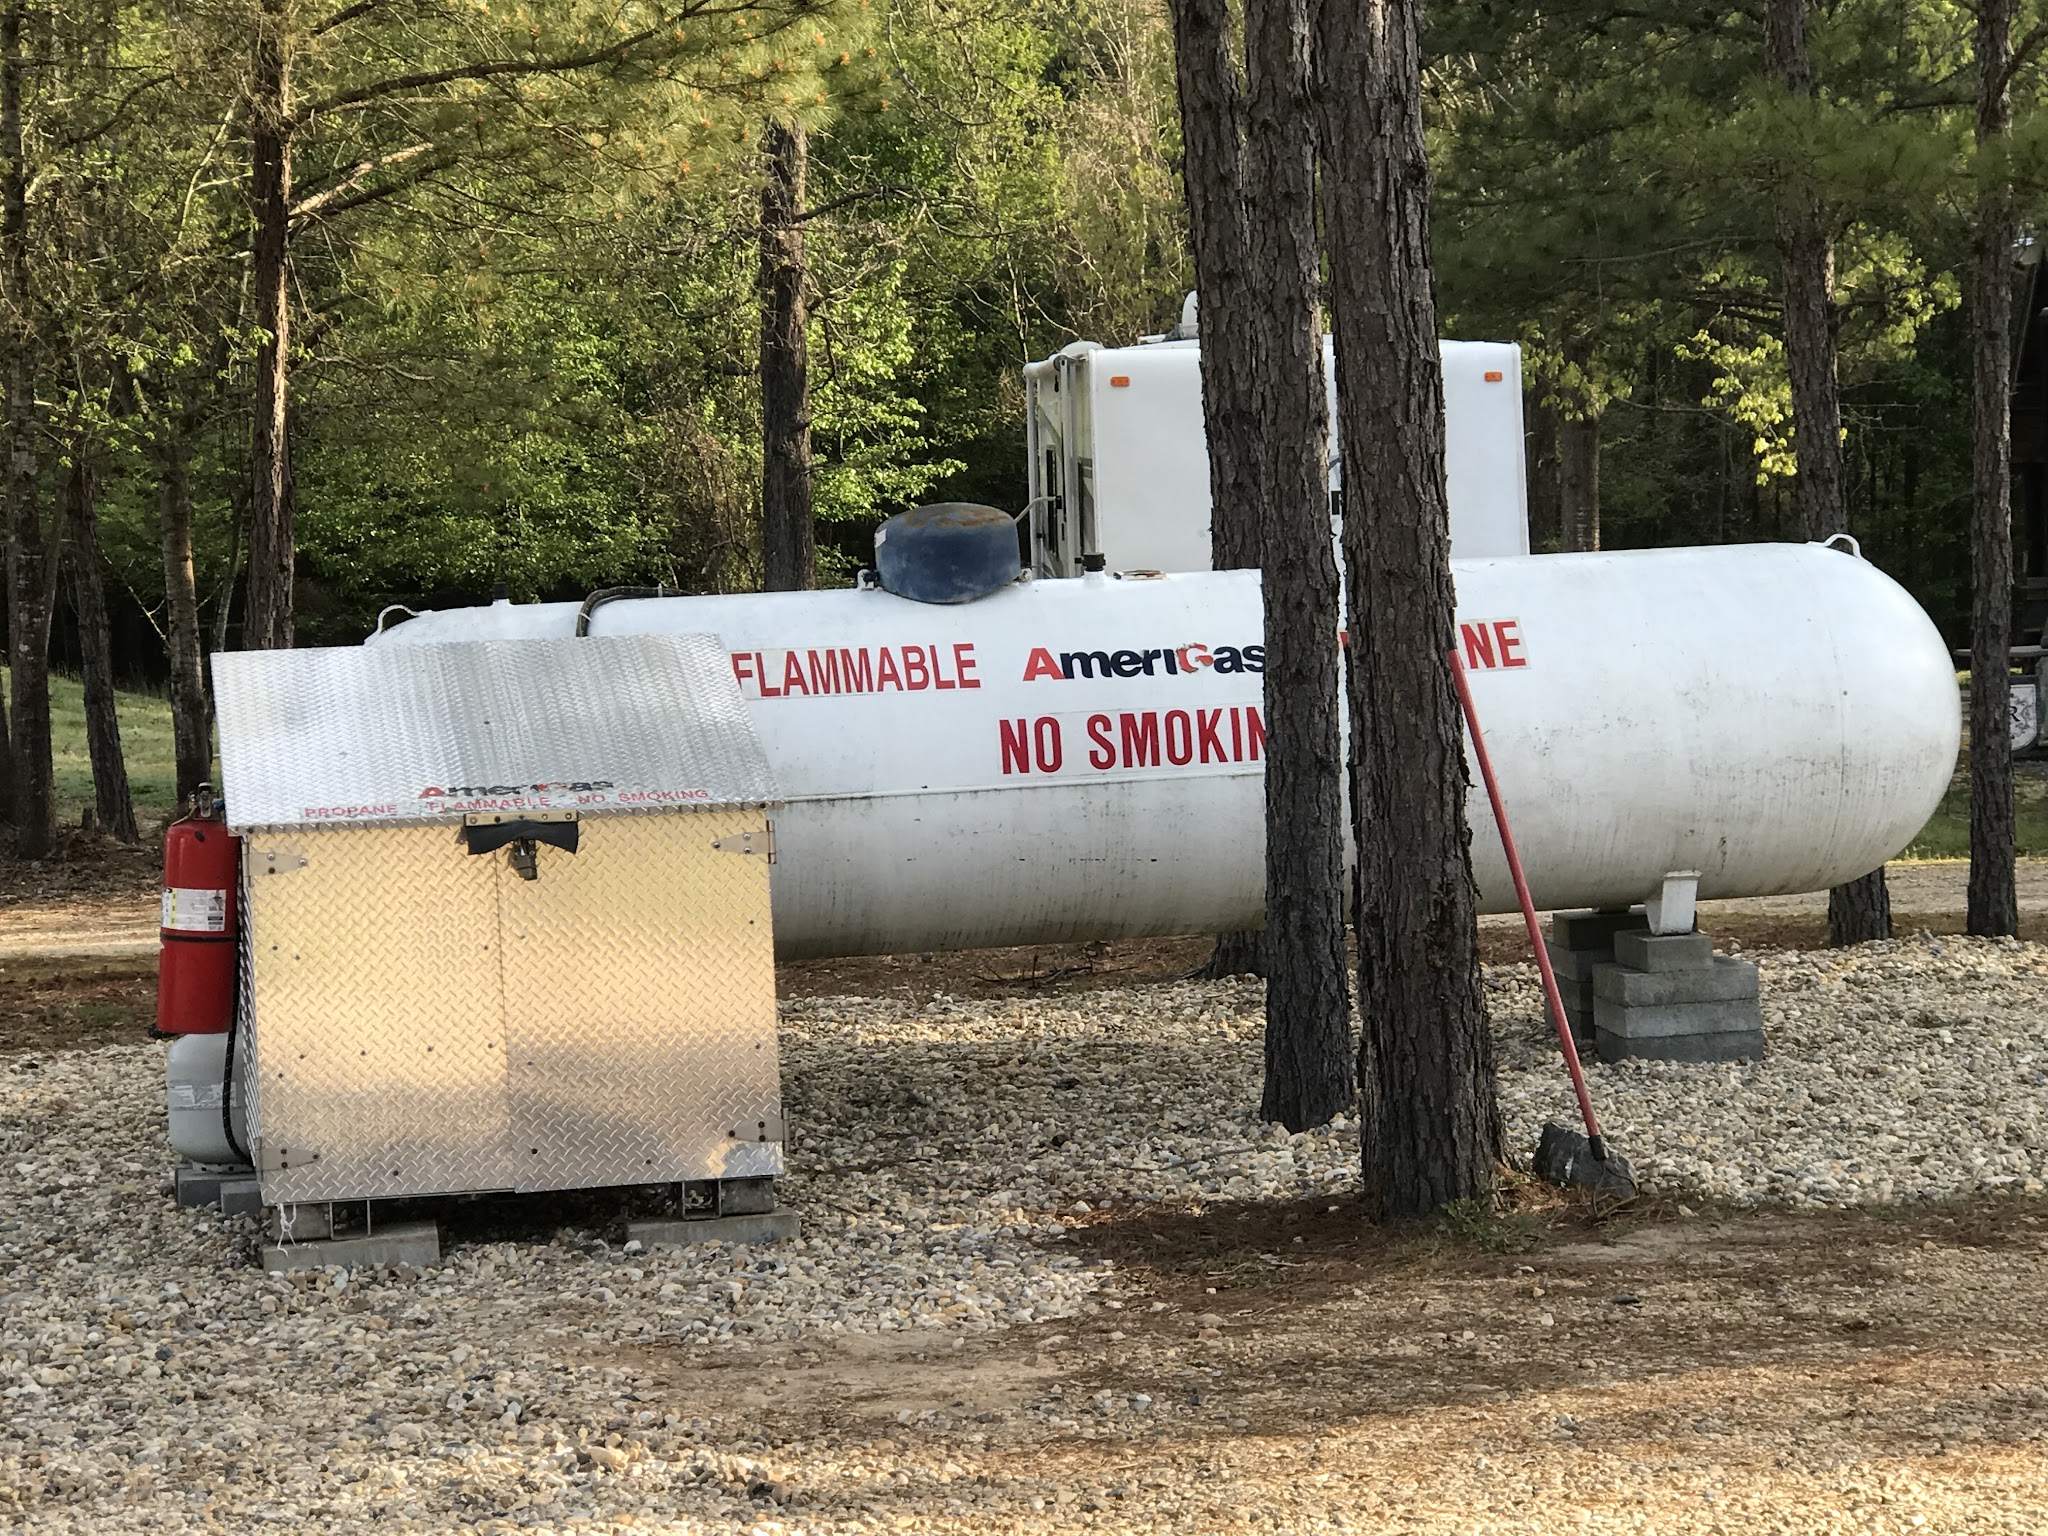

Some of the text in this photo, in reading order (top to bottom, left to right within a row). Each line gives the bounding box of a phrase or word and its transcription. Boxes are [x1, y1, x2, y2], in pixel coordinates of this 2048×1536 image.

[731, 643, 981, 697] FLAMMABLE
[1023, 643, 1265, 681] AmeriGas
[1000, 706, 1266, 774] NO SMOKIN
[304, 789, 709, 818] PROPANE FLAMMABLE NO SMOKING
